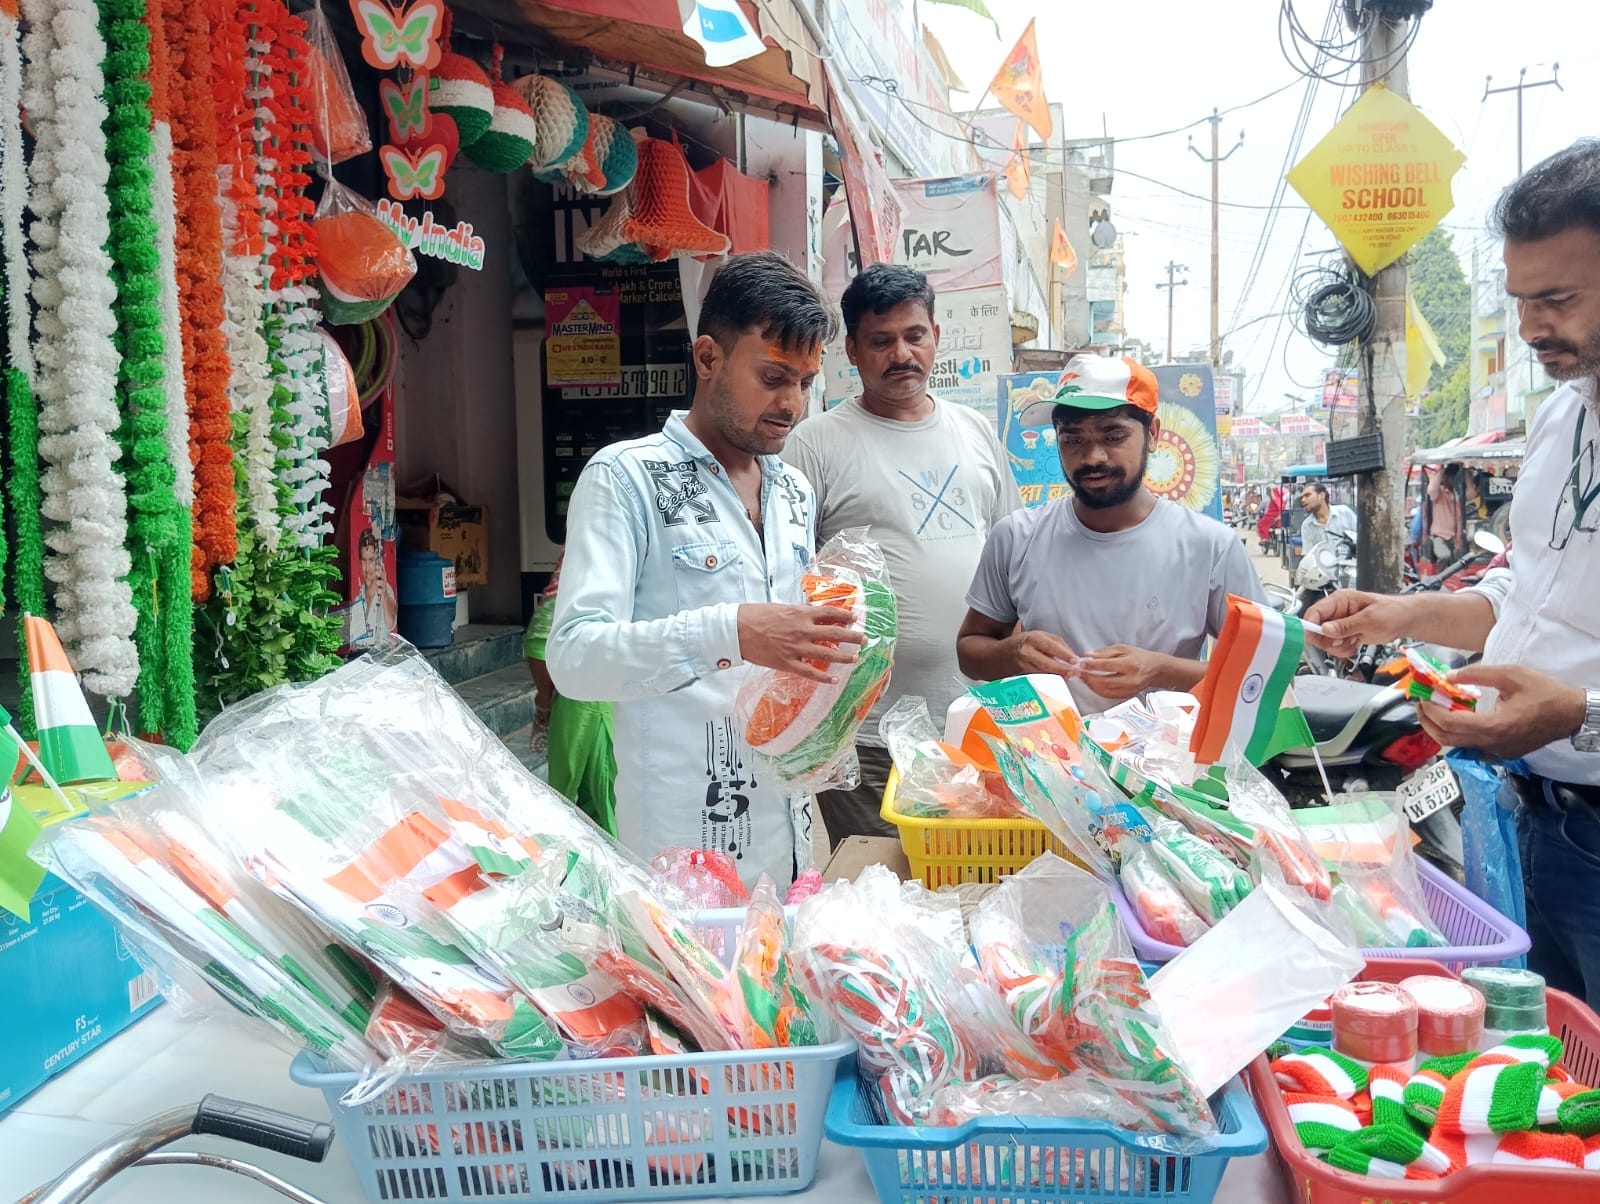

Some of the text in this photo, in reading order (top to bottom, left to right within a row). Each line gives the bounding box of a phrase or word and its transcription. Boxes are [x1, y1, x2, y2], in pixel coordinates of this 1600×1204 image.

[1329, 160, 1441, 187] WISHING BELL
[1342, 186, 1428, 209] SCHOOL
[378, 199, 486, 271] My India
[903, 229, 973, 261] TAR
[648, 279, 673, 291] Crore
[649, 290, 682, 302] Calcula
[931, 357, 991, 378] estion
[929, 374, 959, 389] Bank
[911, 487, 966, 511] 8 3
[937, 511, 953, 531] C
[1427, 766, 1445, 783] 26
[1409, 802, 1425, 820] W
[75, 1014, 87, 1033] FS
[44, 1024, 102, 1070] CENTURY STAR
